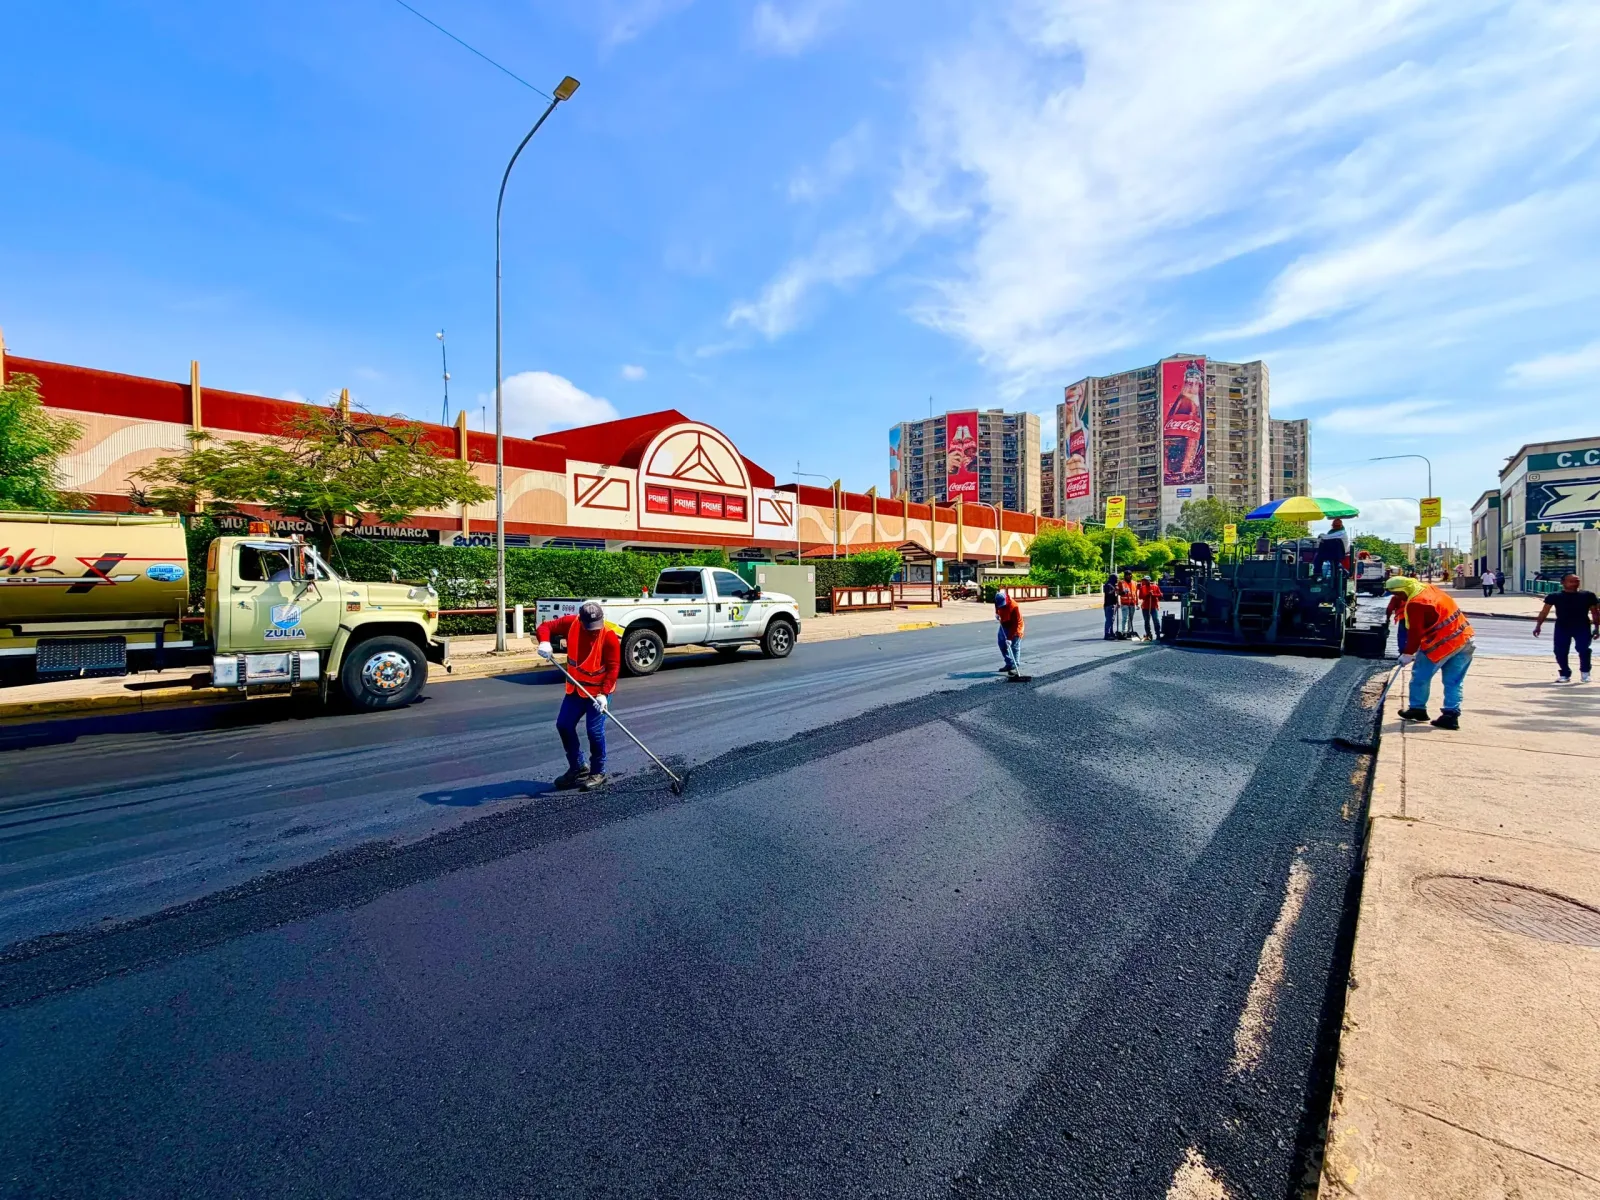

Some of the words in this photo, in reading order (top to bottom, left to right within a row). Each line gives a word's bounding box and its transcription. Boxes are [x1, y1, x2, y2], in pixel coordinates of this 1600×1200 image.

[648, 494, 668, 503] PRIME
[674, 498, 696, 508] PRIME
[701, 501, 722, 511] PRIME
[727, 504, 743, 513] PRIME
[355, 526, 430, 538] MULTIMARCA
[265, 629, 306, 638] ZULIA
